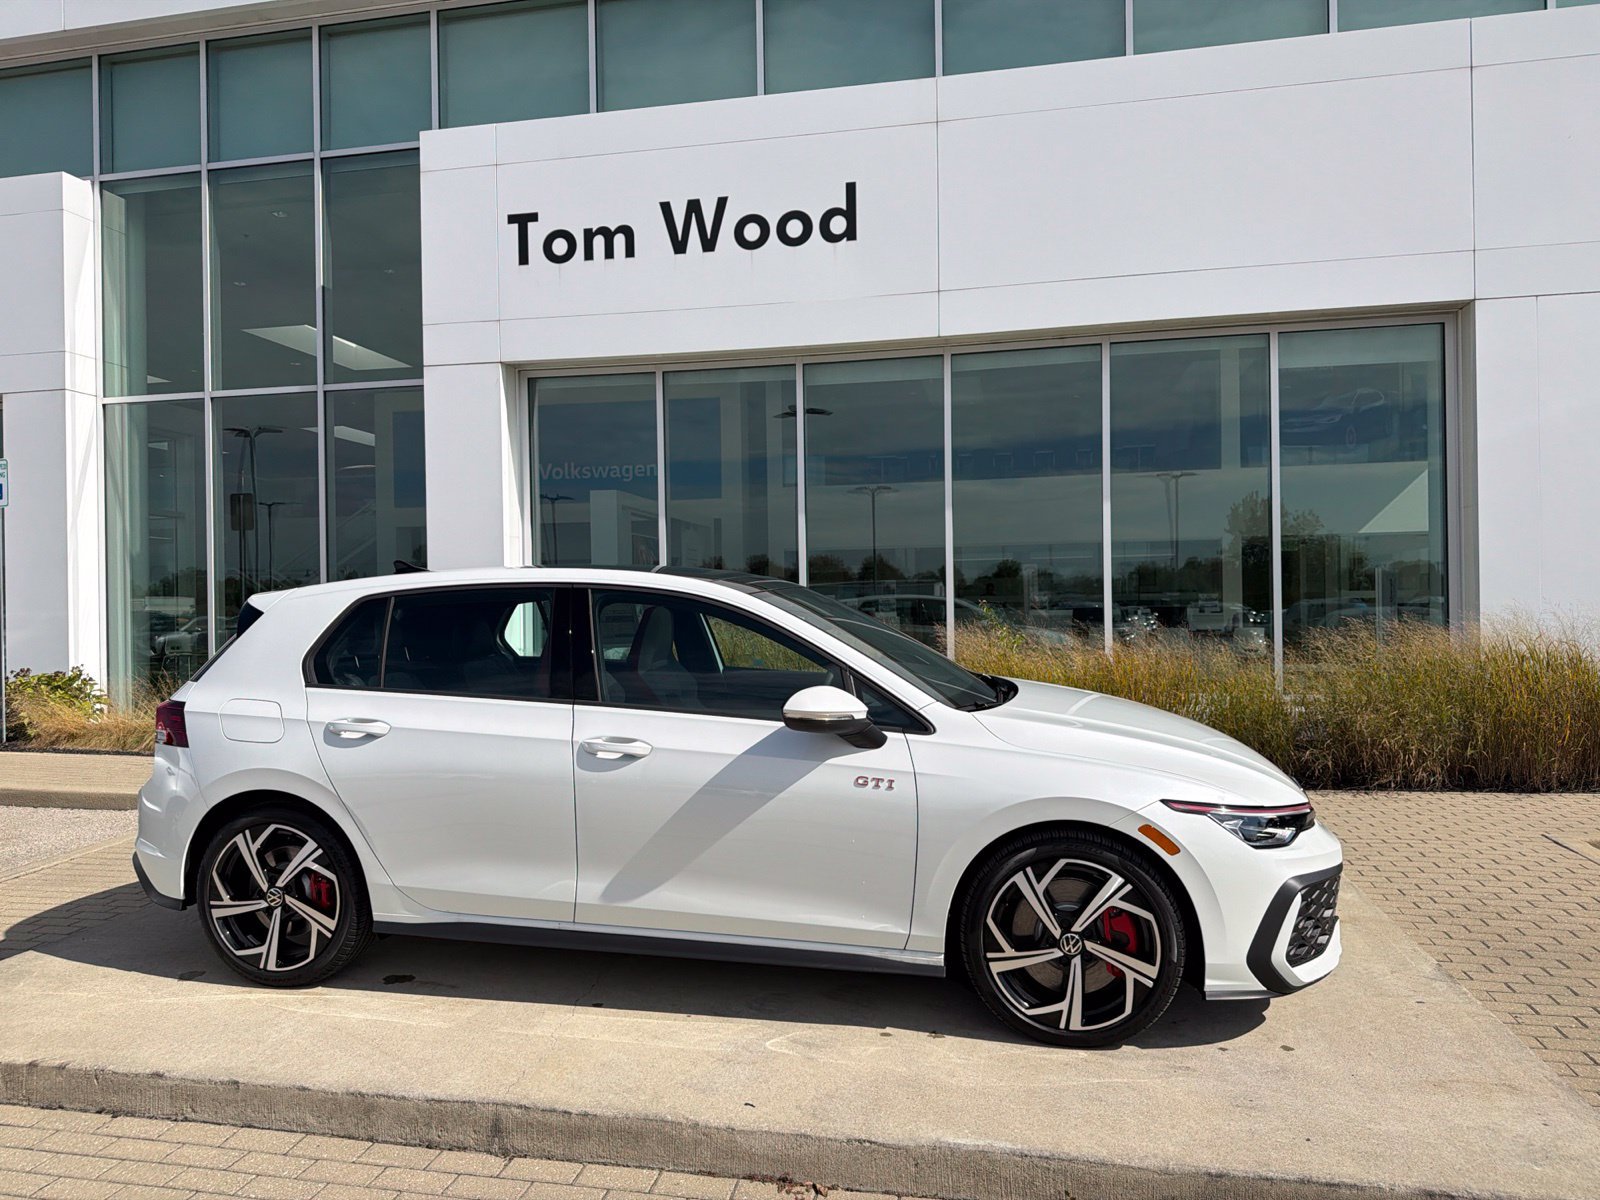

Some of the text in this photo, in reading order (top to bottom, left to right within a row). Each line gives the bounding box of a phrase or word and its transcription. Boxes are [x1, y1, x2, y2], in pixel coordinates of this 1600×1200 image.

[507, 182, 857, 266] Tom Wood
[540, 462, 658, 482] Volkswagen
[853, 775, 895, 791] GTI
